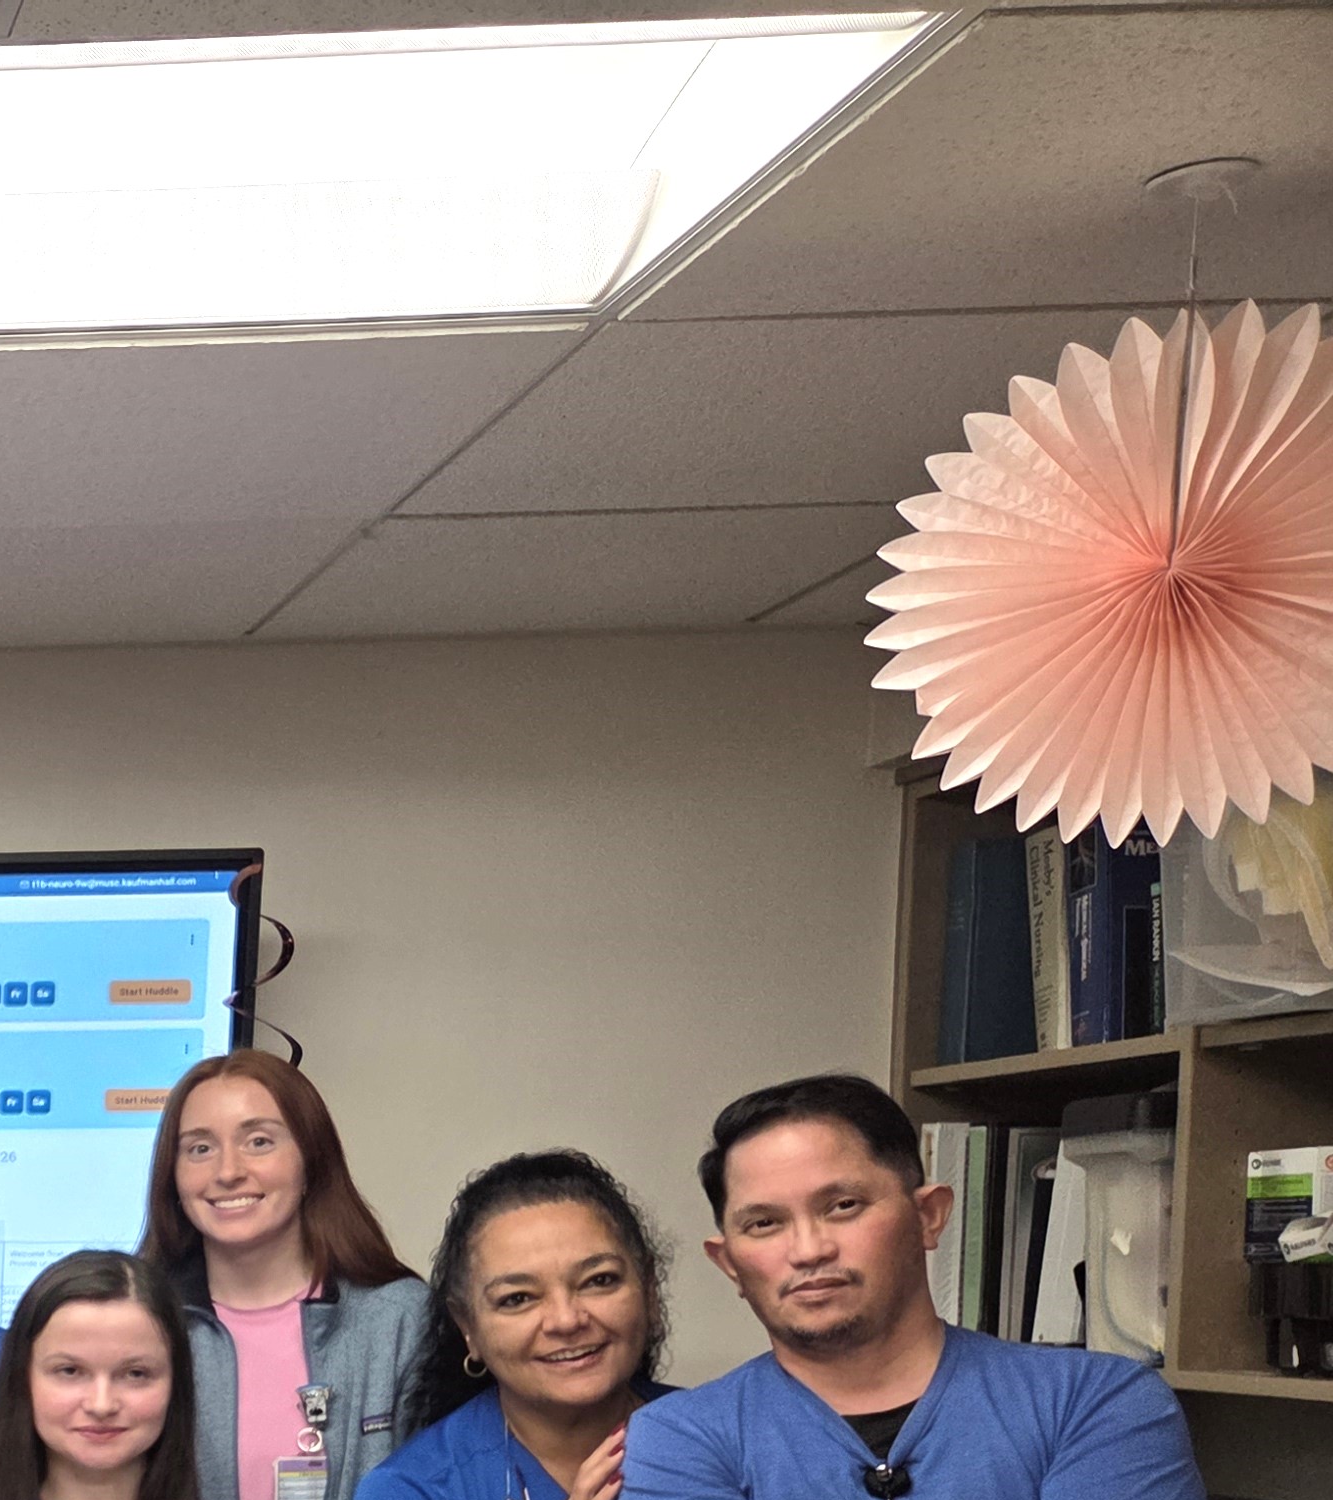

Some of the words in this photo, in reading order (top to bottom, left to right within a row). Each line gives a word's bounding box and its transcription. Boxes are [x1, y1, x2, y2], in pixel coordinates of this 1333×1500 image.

[1029, 845, 1043, 908] Clinical
[1042, 839, 1056, 897] Mosby's
[1151, 898, 1161, 917] IAN
[1033, 911, 1044, 979] Nursing
[1151, 918, 1161, 962] RANKIN
[10, 990, 21, 998] Fr
[120, 988, 142, 996] Start
[145, 986, 179, 996] Huddle
[6, 1098, 17, 1106] Fr
